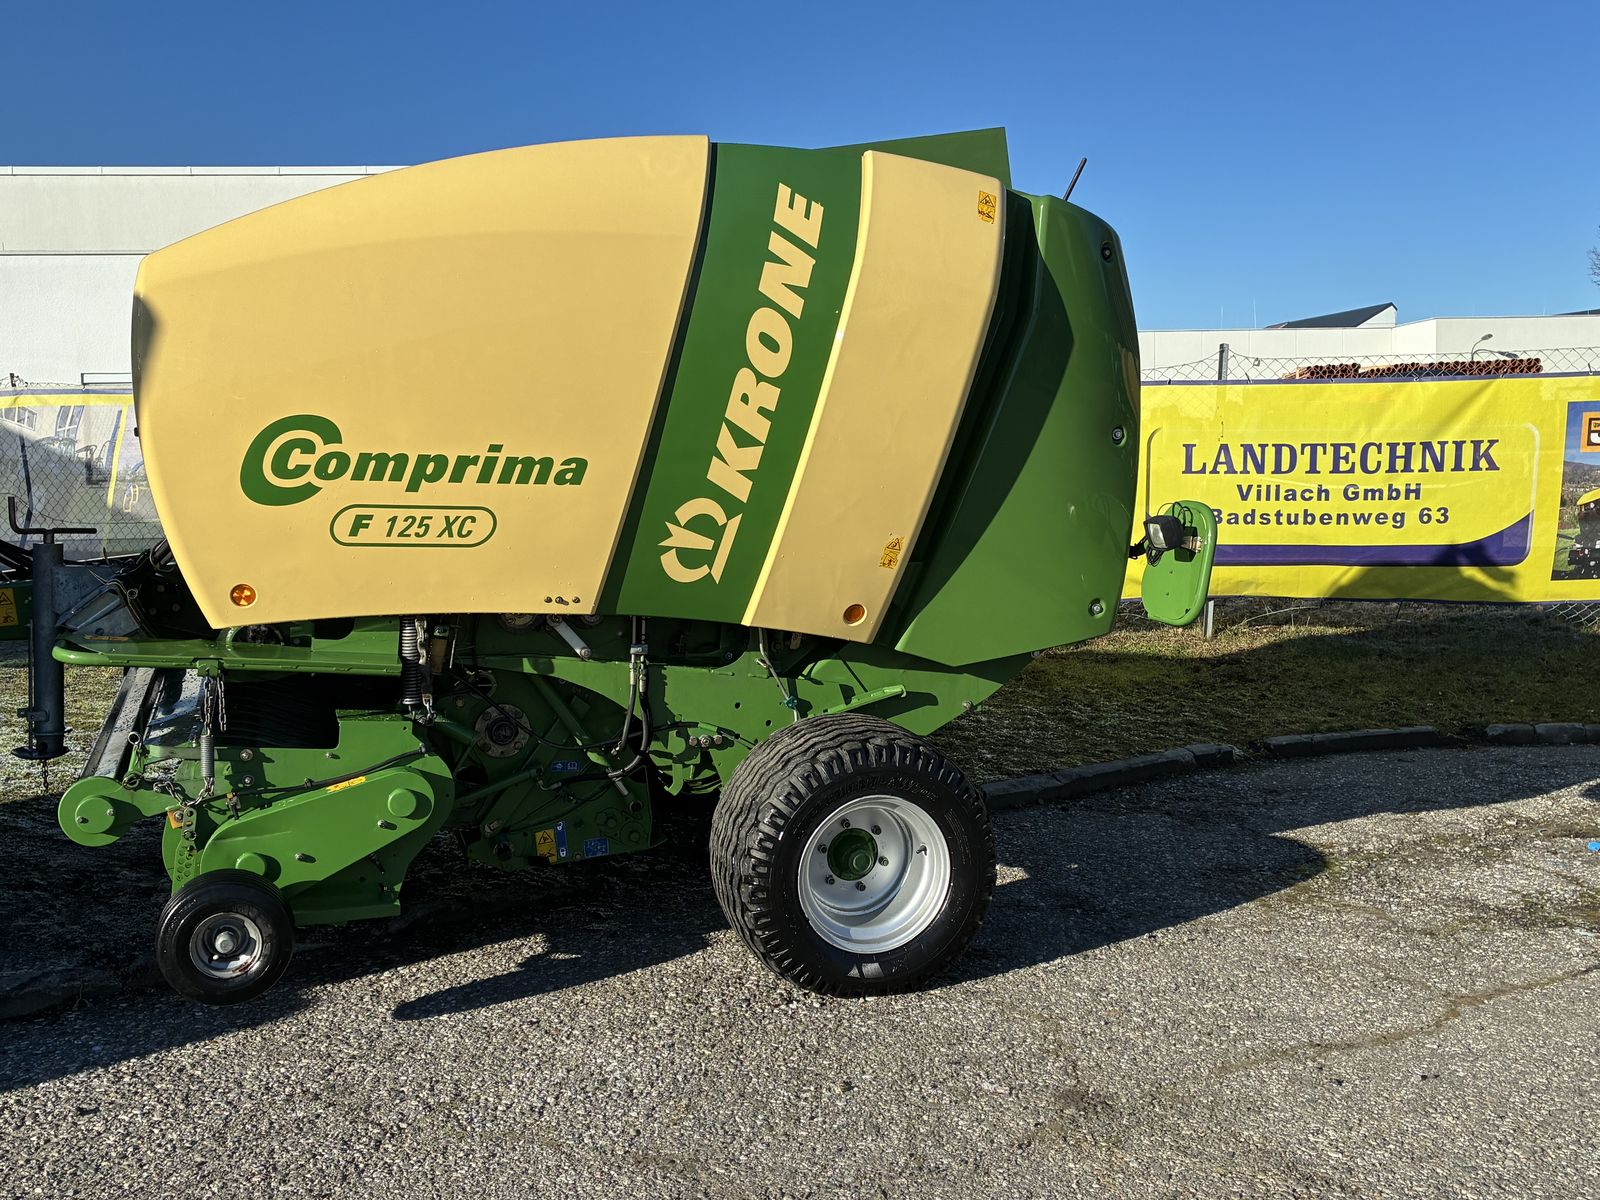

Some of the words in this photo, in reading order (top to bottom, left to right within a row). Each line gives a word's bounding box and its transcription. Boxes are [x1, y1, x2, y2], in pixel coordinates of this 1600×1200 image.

[706, 182, 825, 503] KRONE
[1182, 439, 1500, 475] LANDTECHNIK
[1237, 484, 1331, 502] Villach
[1343, 483, 1422, 501] GmbH
[348, 514, 375, 537] F
[385, 514, 433, 538] 125
[437, 515, 478, 538] XC
[1213, 508, 1406, 528] Badstubenweg
[1418, 506, 1450, 525] 63
